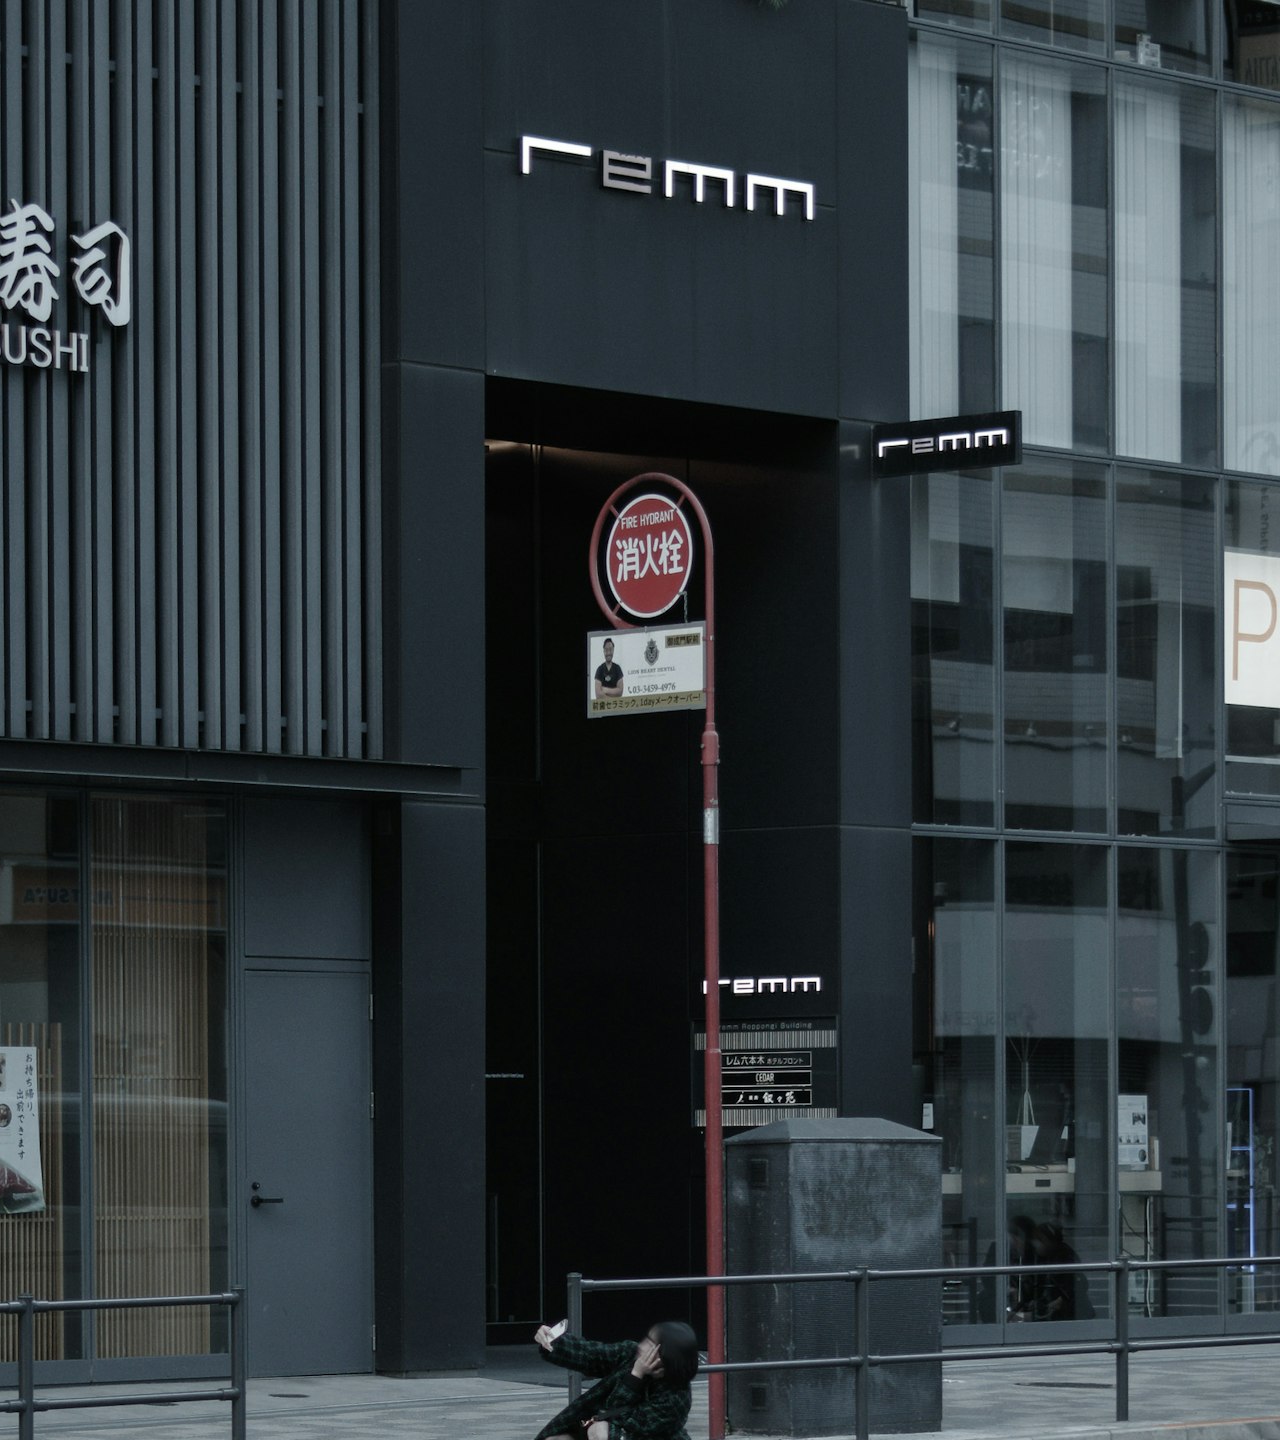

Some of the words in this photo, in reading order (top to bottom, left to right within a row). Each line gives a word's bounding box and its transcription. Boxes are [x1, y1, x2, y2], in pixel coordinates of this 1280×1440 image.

[521, 135, 814, 220] remm
[878, 428, 1008, 458] remm
[621, 515, 638, 530] FIRE
[640, 509, 675, 527] HYDRANT
[616, 528, 684, 583] 消火栓
[741, 1022, 778, 1031] Roppongi
[780, 1021, 813, 1030] Building
[726, 1057, 765, 1066] レム六本木
[755, 1072, 775, 1082] CEDAR
